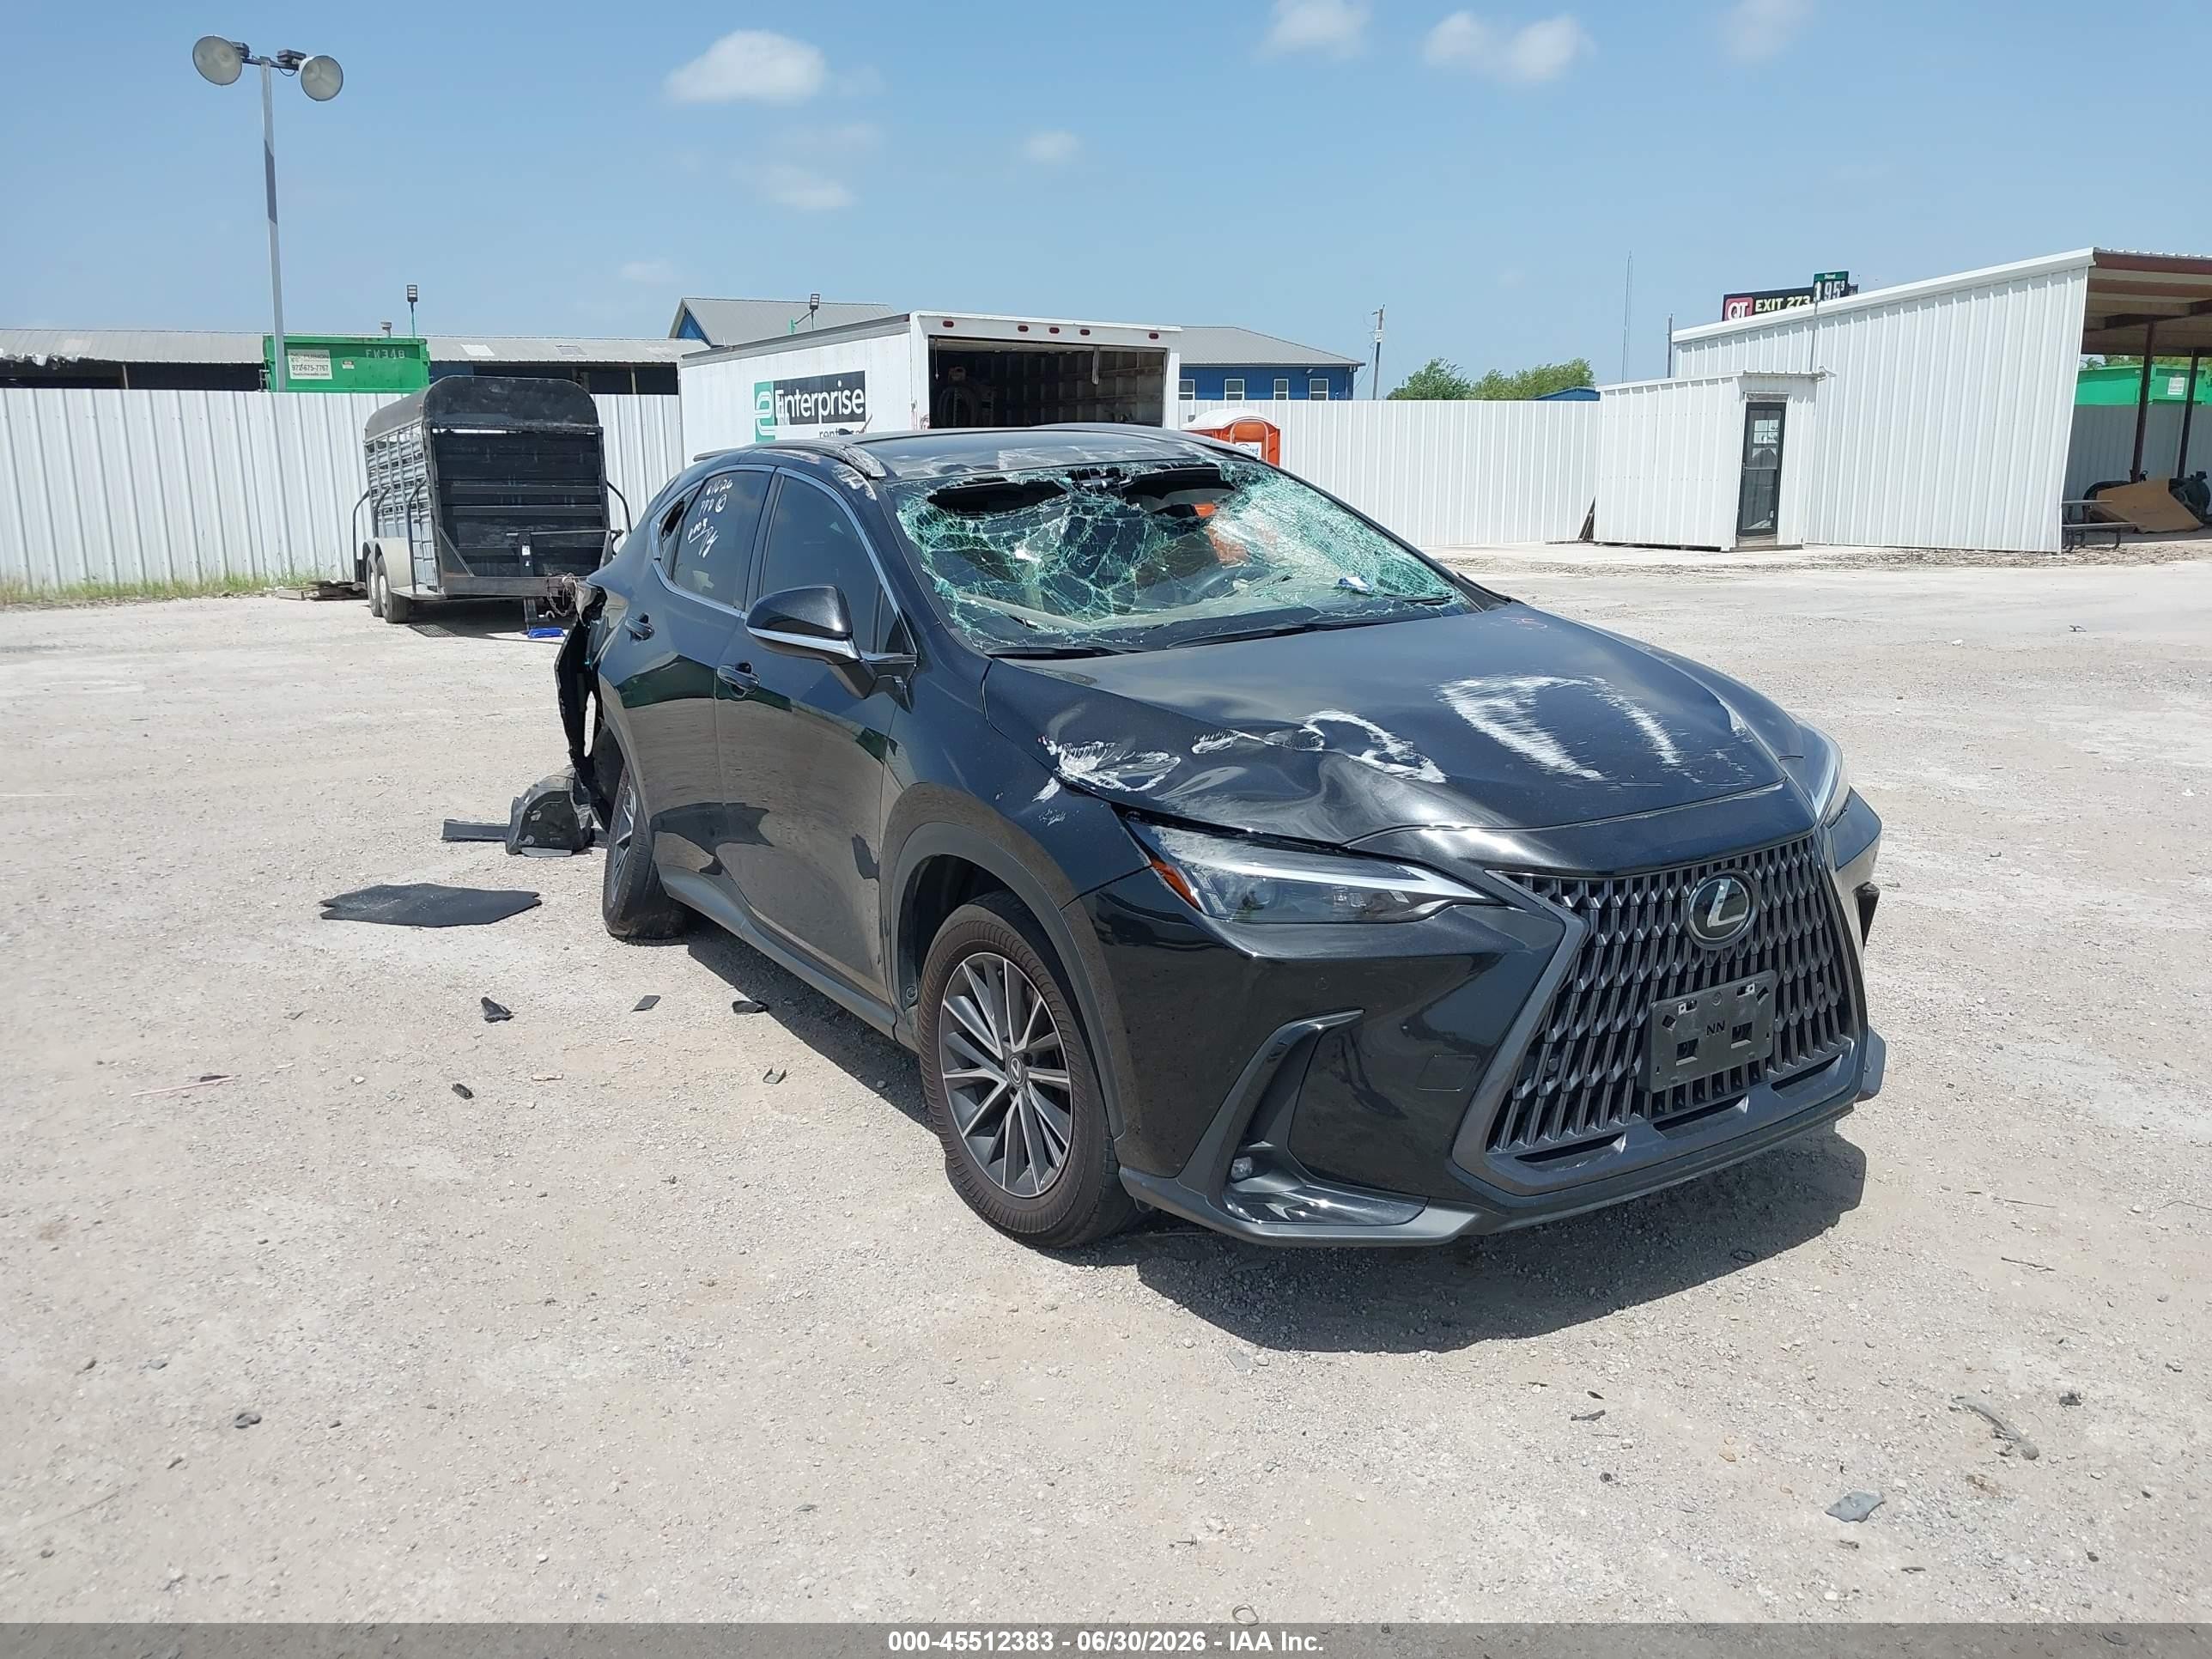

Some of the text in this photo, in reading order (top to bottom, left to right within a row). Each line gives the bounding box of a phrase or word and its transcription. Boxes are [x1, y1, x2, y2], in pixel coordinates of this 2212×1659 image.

[1728, 301, 1748, 320] QT
[1755, 295, 1810, 312] EXIT 273
[365, 349, 404, 359] FW348
[775, 380, 864, 424] Enterprise
